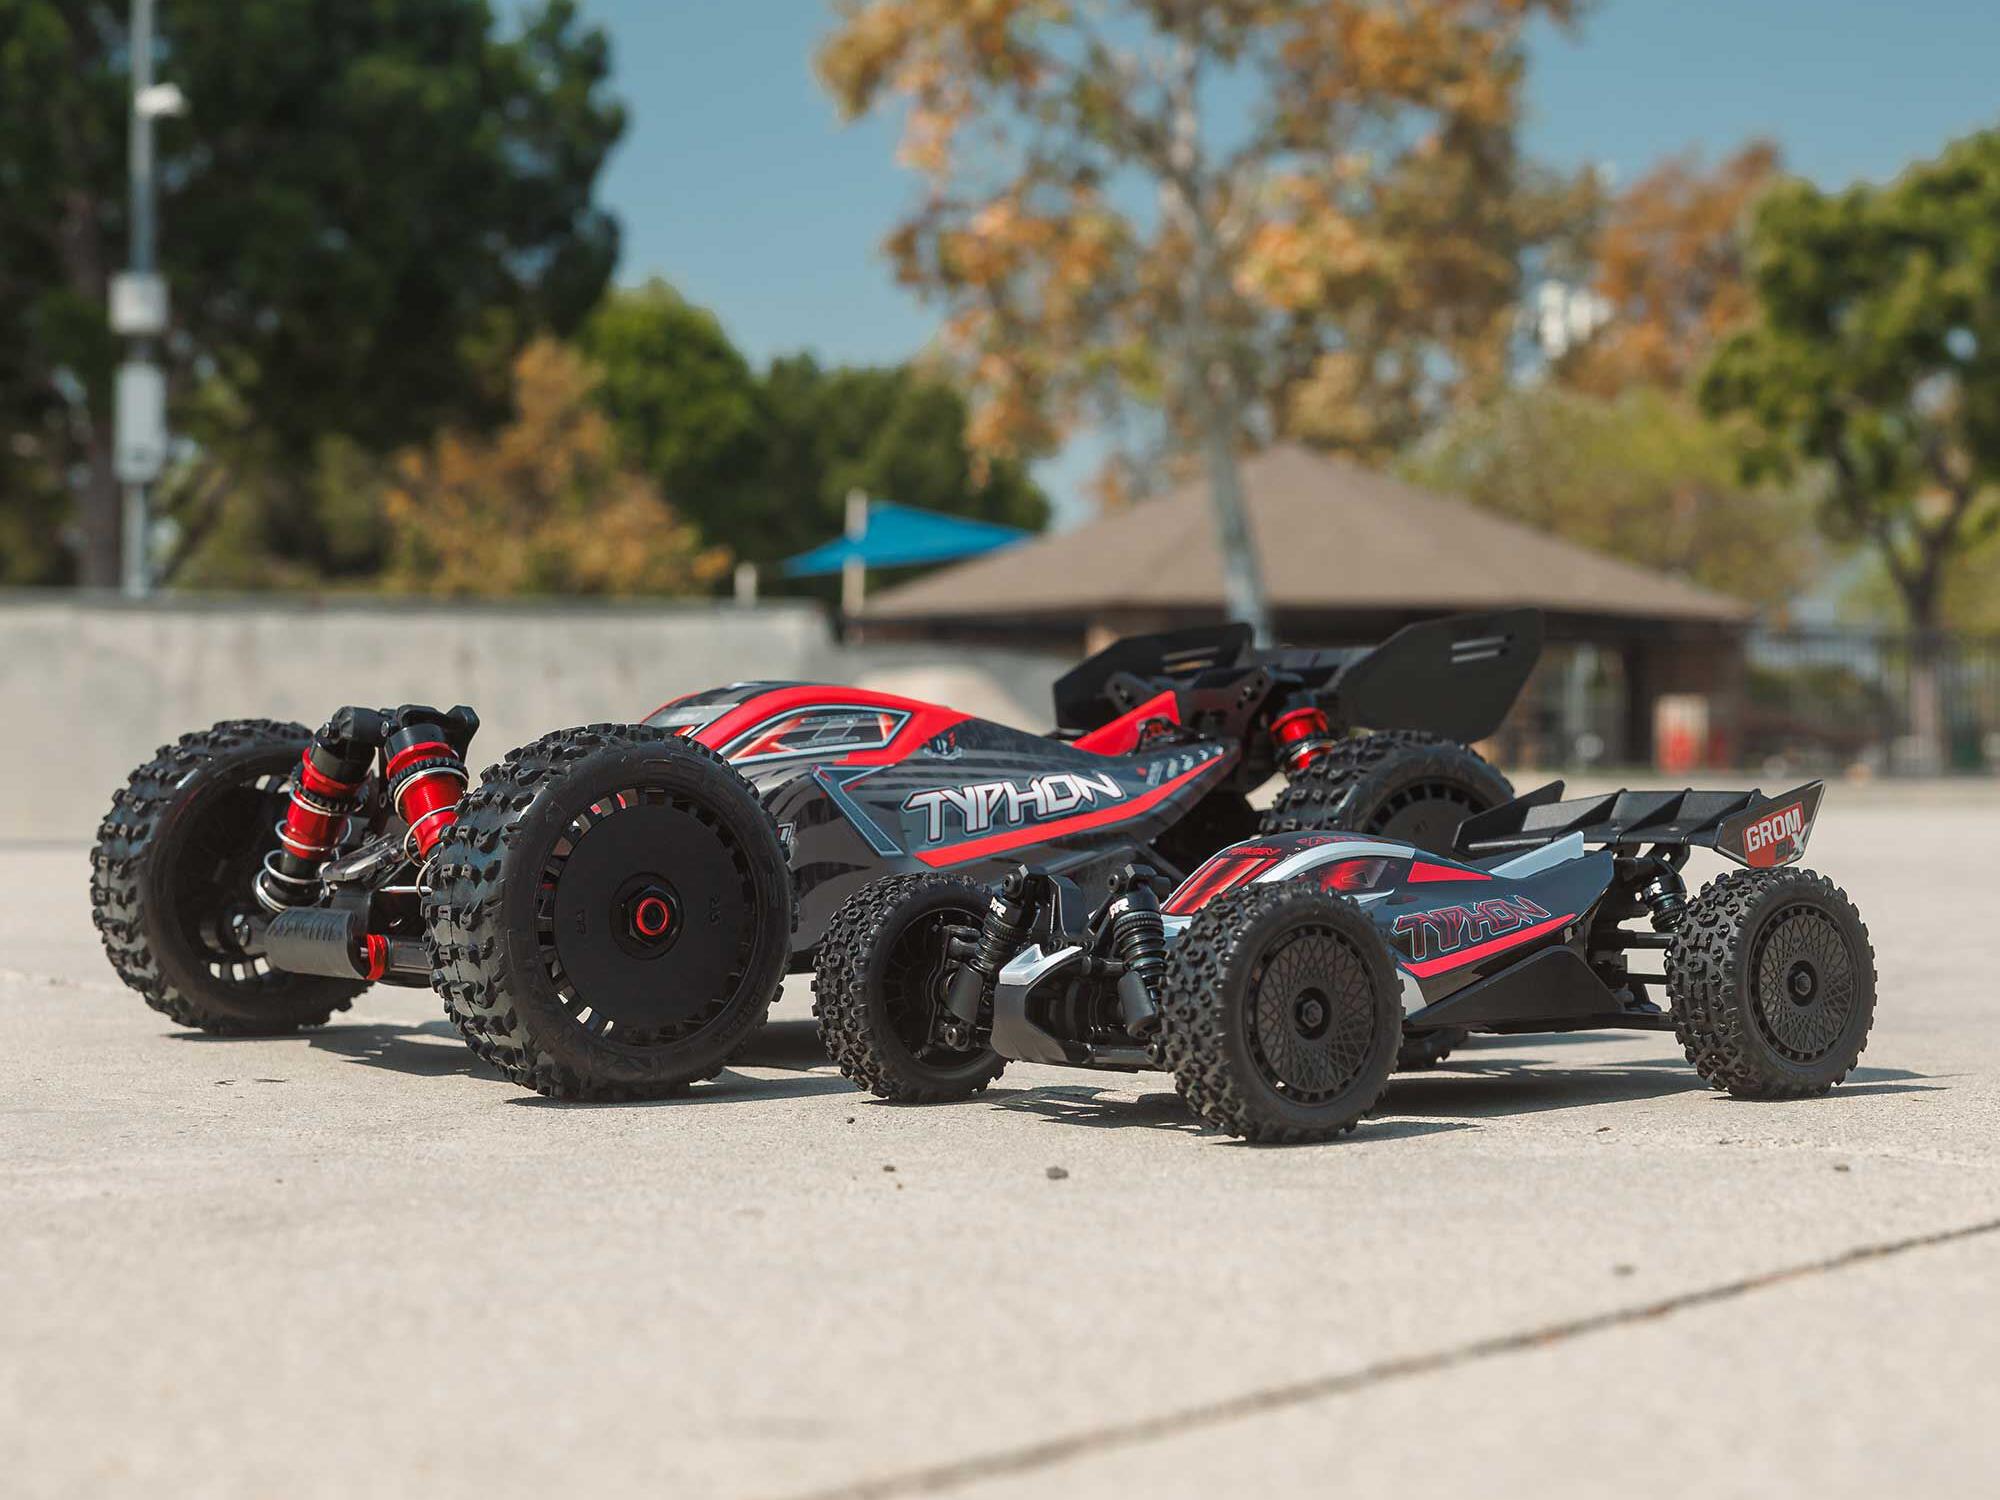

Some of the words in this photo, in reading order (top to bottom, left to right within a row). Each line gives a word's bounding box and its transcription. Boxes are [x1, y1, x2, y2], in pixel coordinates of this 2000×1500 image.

[904, 771, 1125, 842] TYPHON
[1746, 808, 1802, 853] GROM
[1391, 895, 1551, 961] TYPHON
